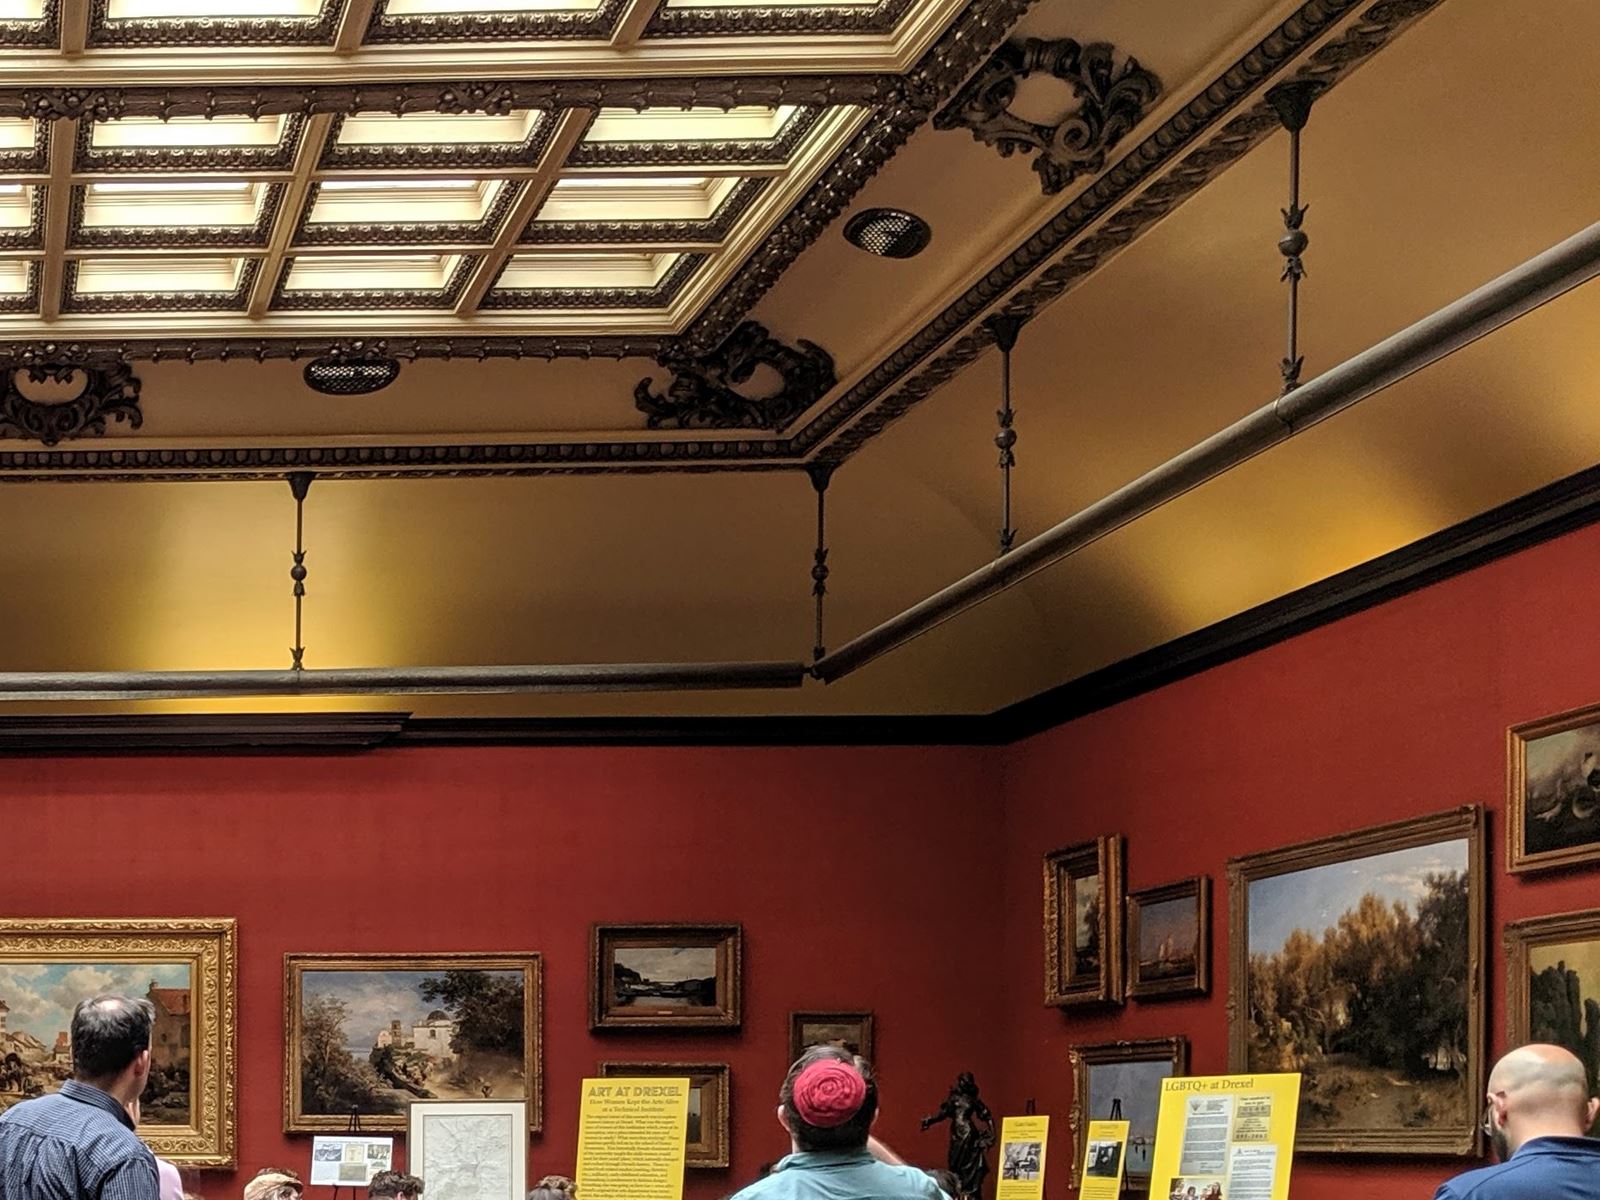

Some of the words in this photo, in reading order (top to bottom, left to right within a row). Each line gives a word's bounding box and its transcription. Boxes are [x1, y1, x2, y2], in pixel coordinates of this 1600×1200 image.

[588, 1086, 612, 1097] ART
[615, 1086, 630, 1097] AT
[633, 1086, 682, 1097] DREXEL
[1165, 1081, 1207, 1092] LGBTQ+
[1222, 1079, 1254, 1090] Drexel
